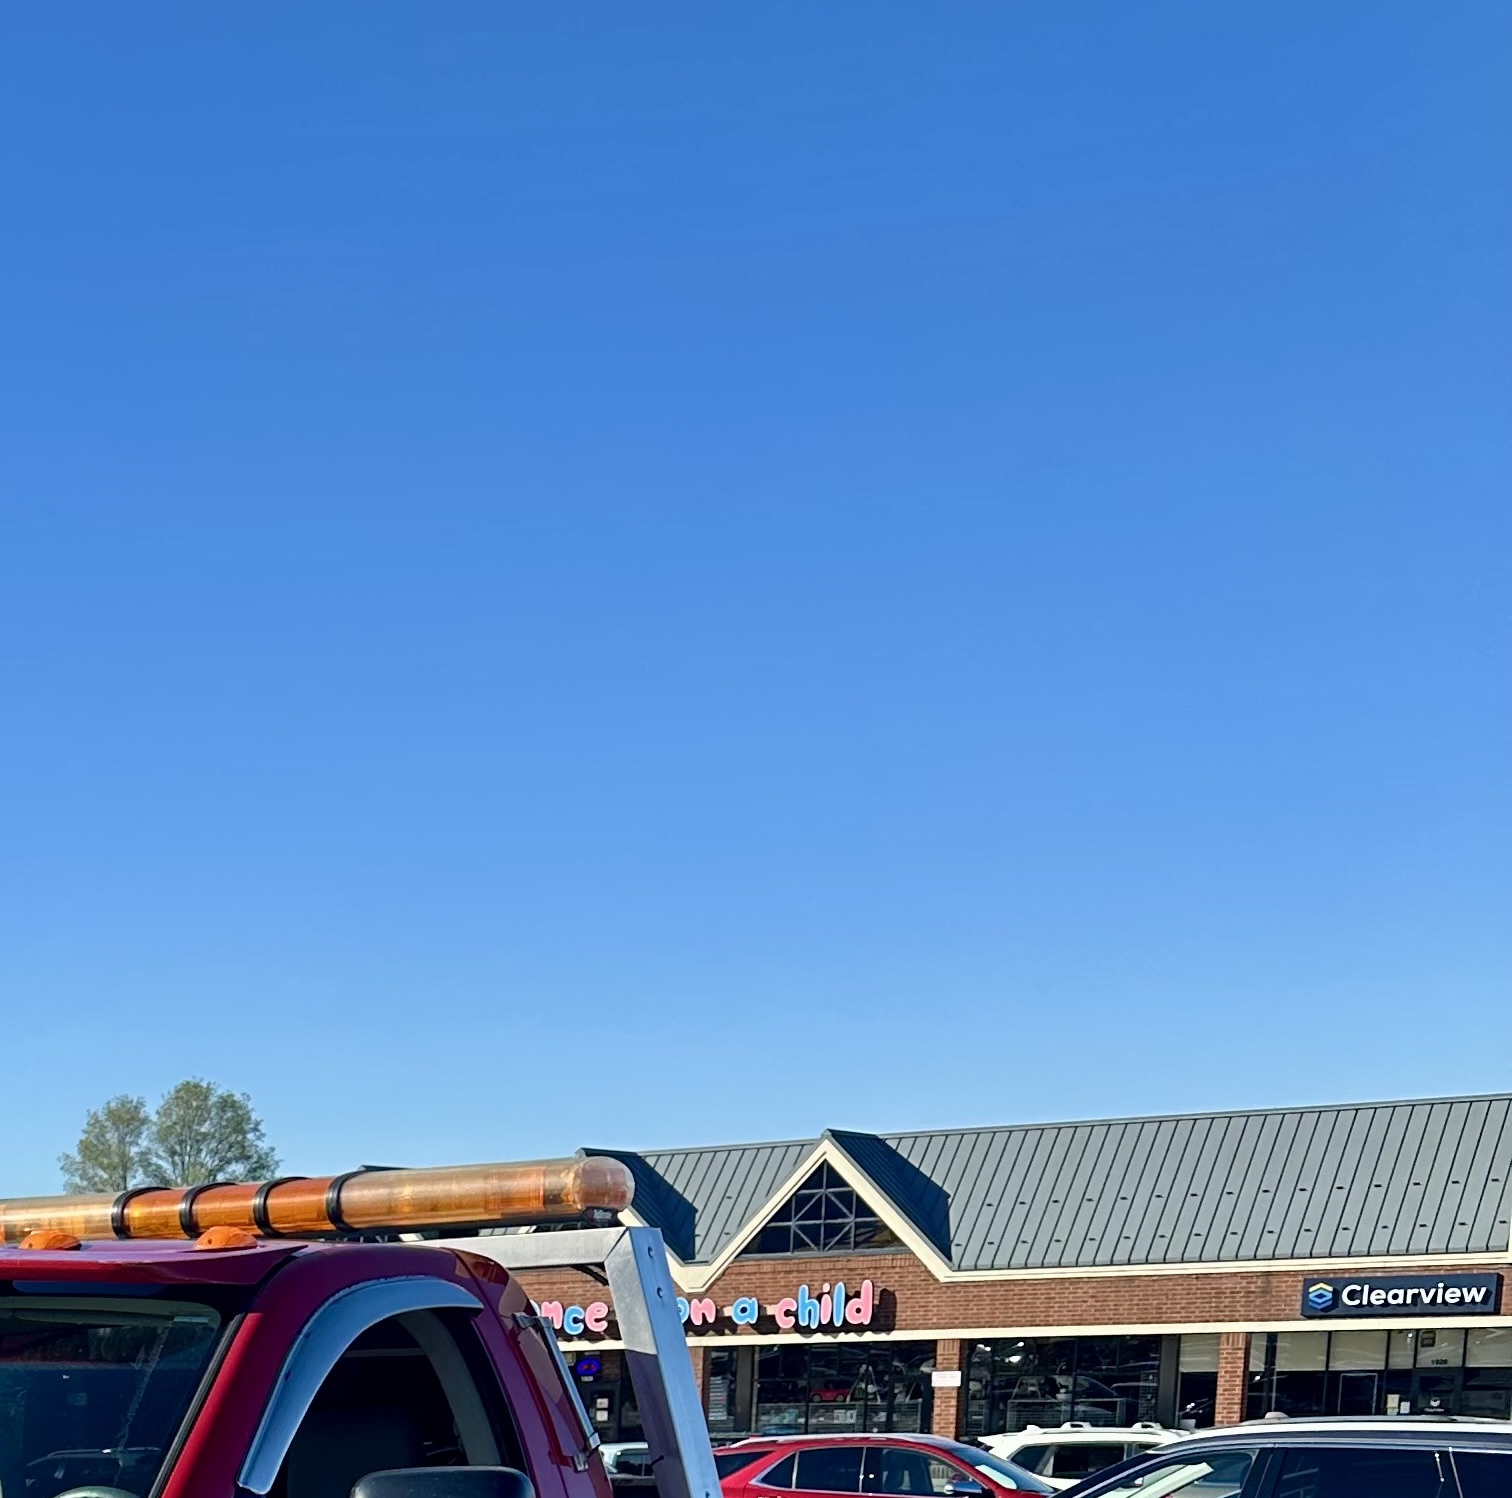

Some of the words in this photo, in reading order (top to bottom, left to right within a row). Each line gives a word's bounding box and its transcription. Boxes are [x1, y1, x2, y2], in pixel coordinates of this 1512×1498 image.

[530, 1300, 609, 1335] nce
[732, 1296, 759, 1325] a
[775, 1279, 874, 1329] child
[1341, 1282, 1487, 1306] Clearview
